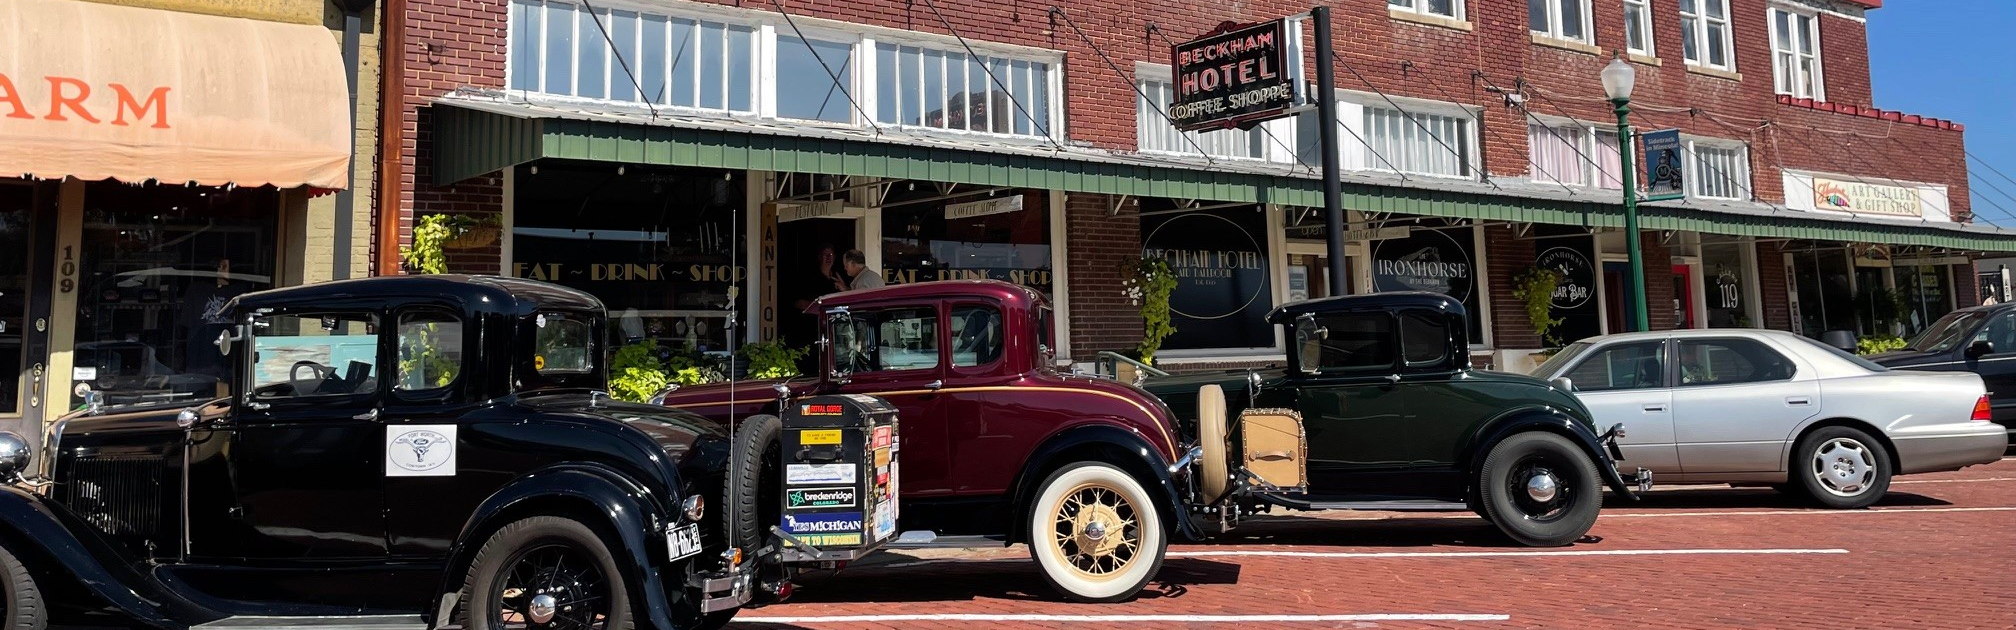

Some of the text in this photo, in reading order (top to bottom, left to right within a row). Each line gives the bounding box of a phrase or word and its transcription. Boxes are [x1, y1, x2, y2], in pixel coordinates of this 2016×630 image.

[1179, 30, 1274, 66] BECKHAM
[1182, 56, 1277, 96] HOTEL
[1168, 82, 1291, 120] COFFEE SHOPPE
[1852, 185, 1870, 198] ART
[1874, 186, 1916, 202] GALLERY
[1864, 200, 1888, 212] GIFT
[1890, 201, 1916, 213] SHOP
[60, 244, 76, 294] 109
[1218, 250, 1261, 270] HOTEL
[1378, 259, 1467, 278] IRONHORSE
[513, 262, 563, 281] EAT
[591, 263, 665, 281] DRINK
[690, 263, 747, 281] SHOP
[882, 268, 918, 284] EAT
[938, 269, 991, 281] DRINK
[1009, 269, 1051, 285] SHOP
[1720, 283, 1738, 309] 119
[804, 491, 853, 502] breckenridge
[811, 535, 821, 546] TO
[822, 534, 861, 545] WISCONSIN
